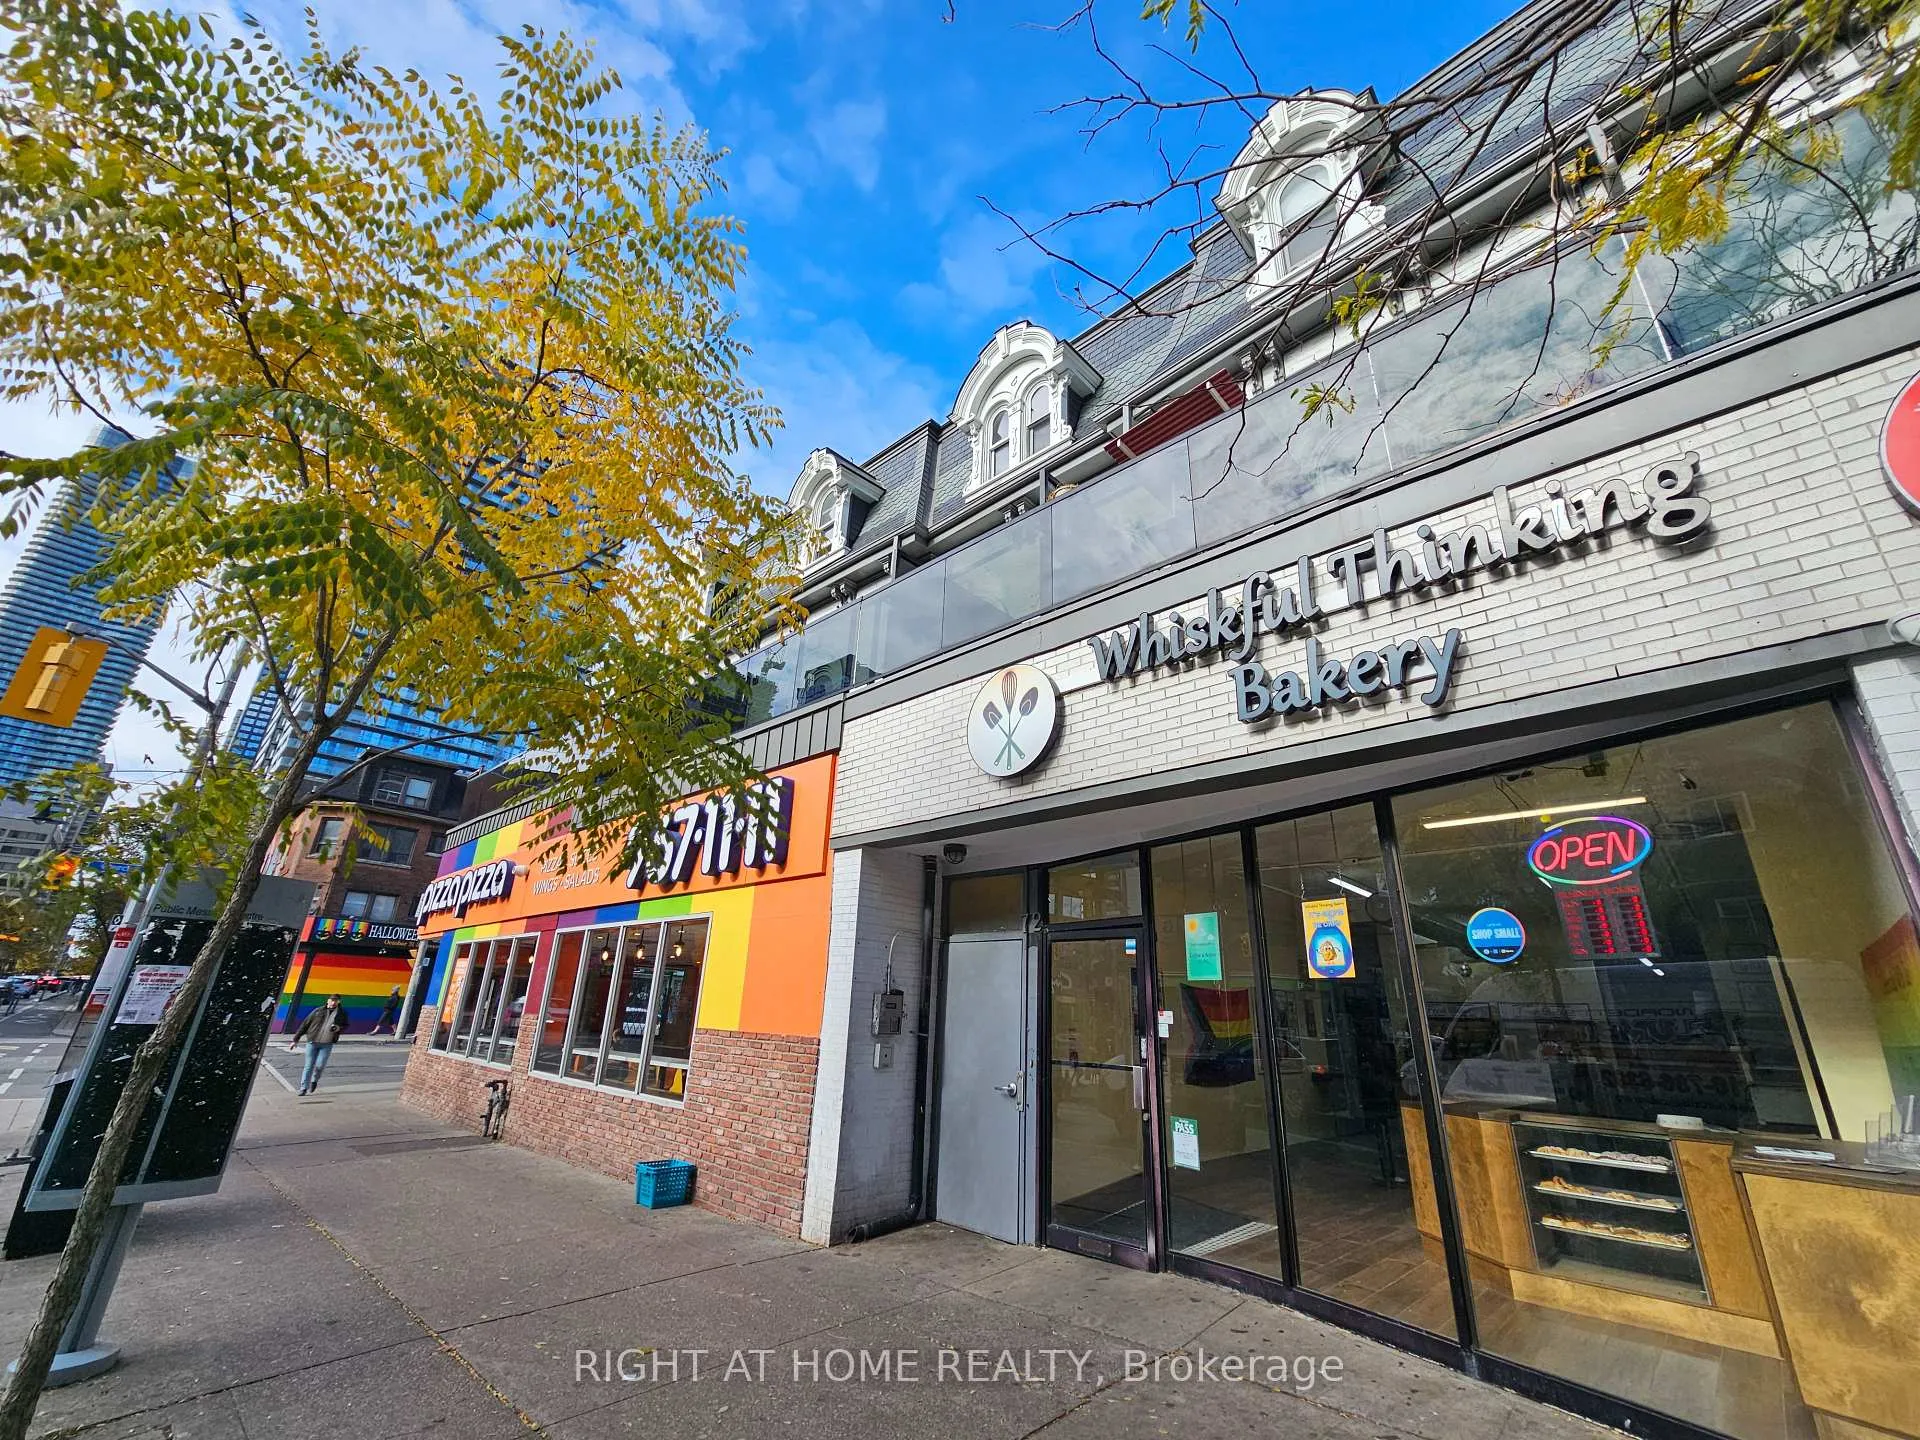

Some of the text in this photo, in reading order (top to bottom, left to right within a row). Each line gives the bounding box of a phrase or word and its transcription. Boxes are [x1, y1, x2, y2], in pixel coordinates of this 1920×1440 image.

[1089, 450, 1712, 681] Whiskful Thinking
[1228, 627, 1461, 724] Bakery
[1533, 828, 1636, 871] OPEN
[533, 867, 601, 896] WINGS SALADS
[152, 903, 185, 914] Public
[368, 925, 420, 941] HALLOWEE
[1471, 927, 1521, 940] SHOP SMALL
[1174, 1121, 1195, 1135] PASS
